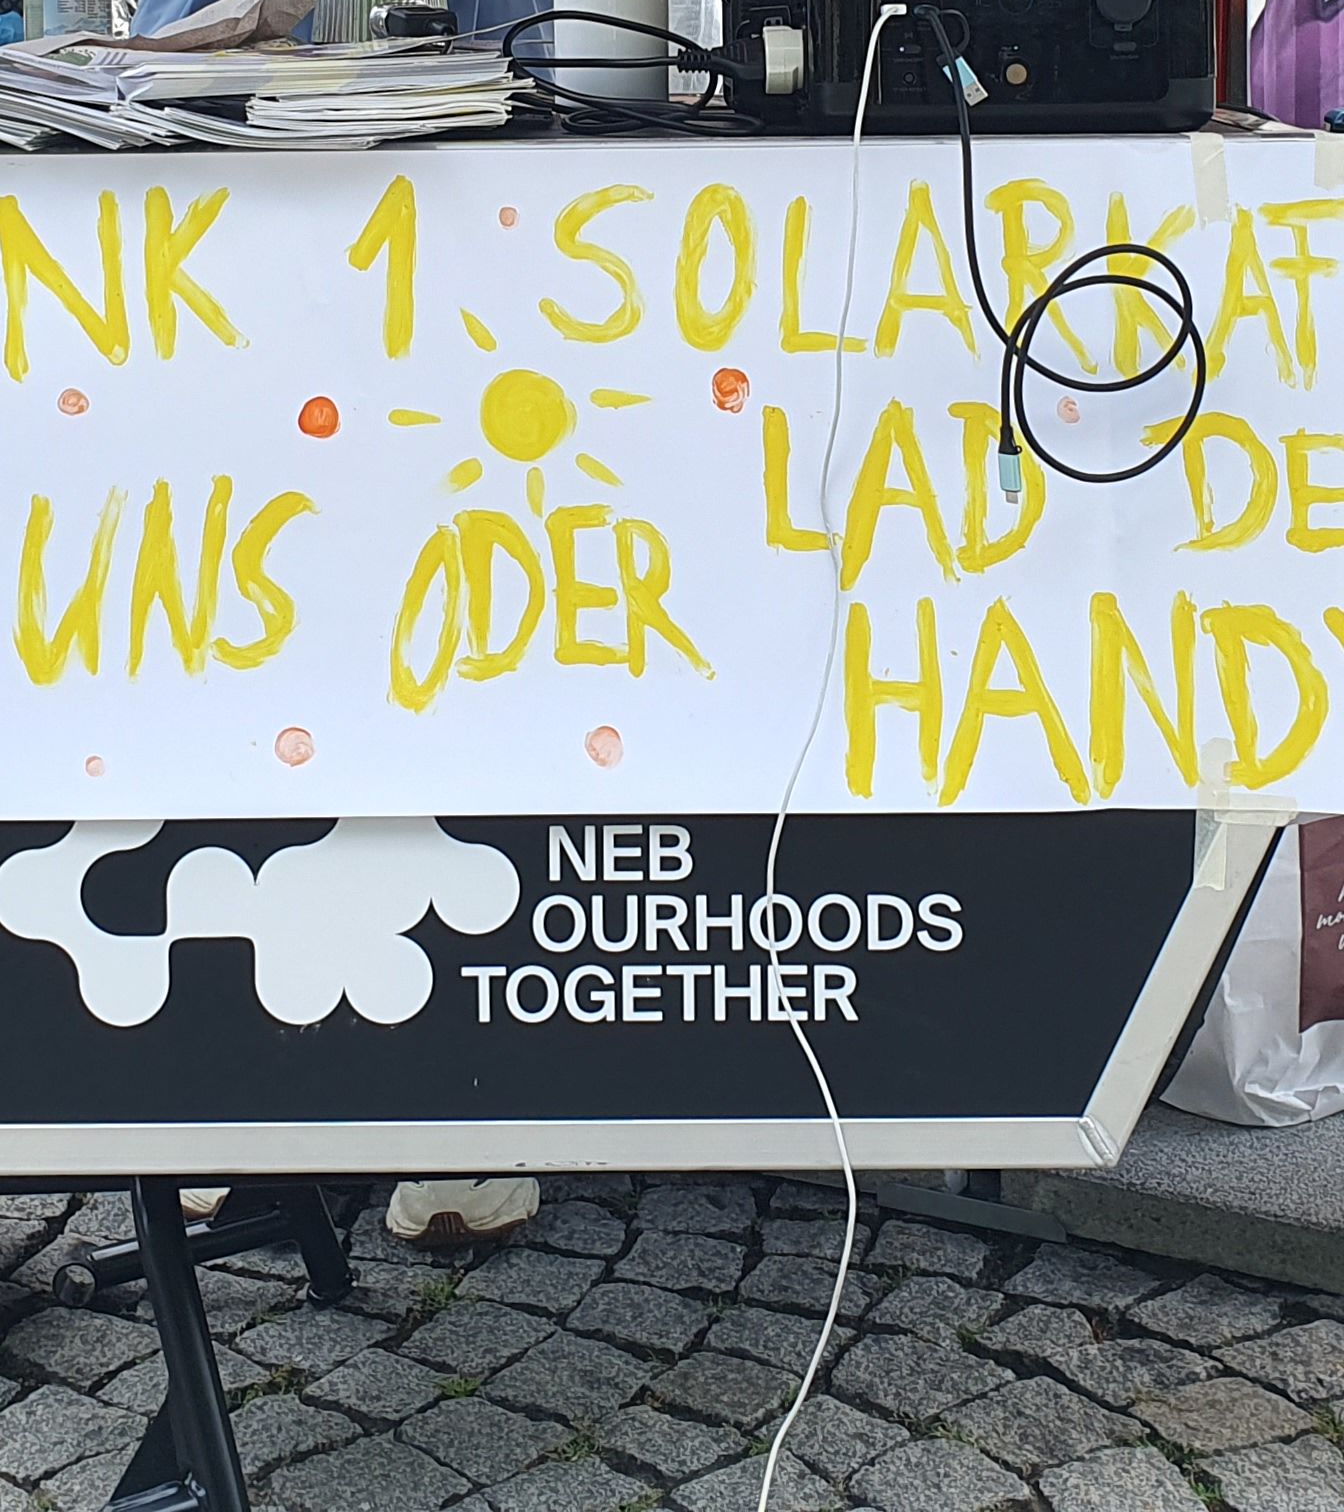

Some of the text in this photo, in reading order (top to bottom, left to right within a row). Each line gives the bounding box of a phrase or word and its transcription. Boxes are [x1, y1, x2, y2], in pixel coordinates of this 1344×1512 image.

[761, 398, 1046, 591] LAD
[12, 473, 321, 686] UNS
[387, 503, 716, 713] ODER
[549, 824, 693, 882] NEB
[532, 893, 963, 953] OURHOODS
[461, 963, 858, 1023] TOGETHER
